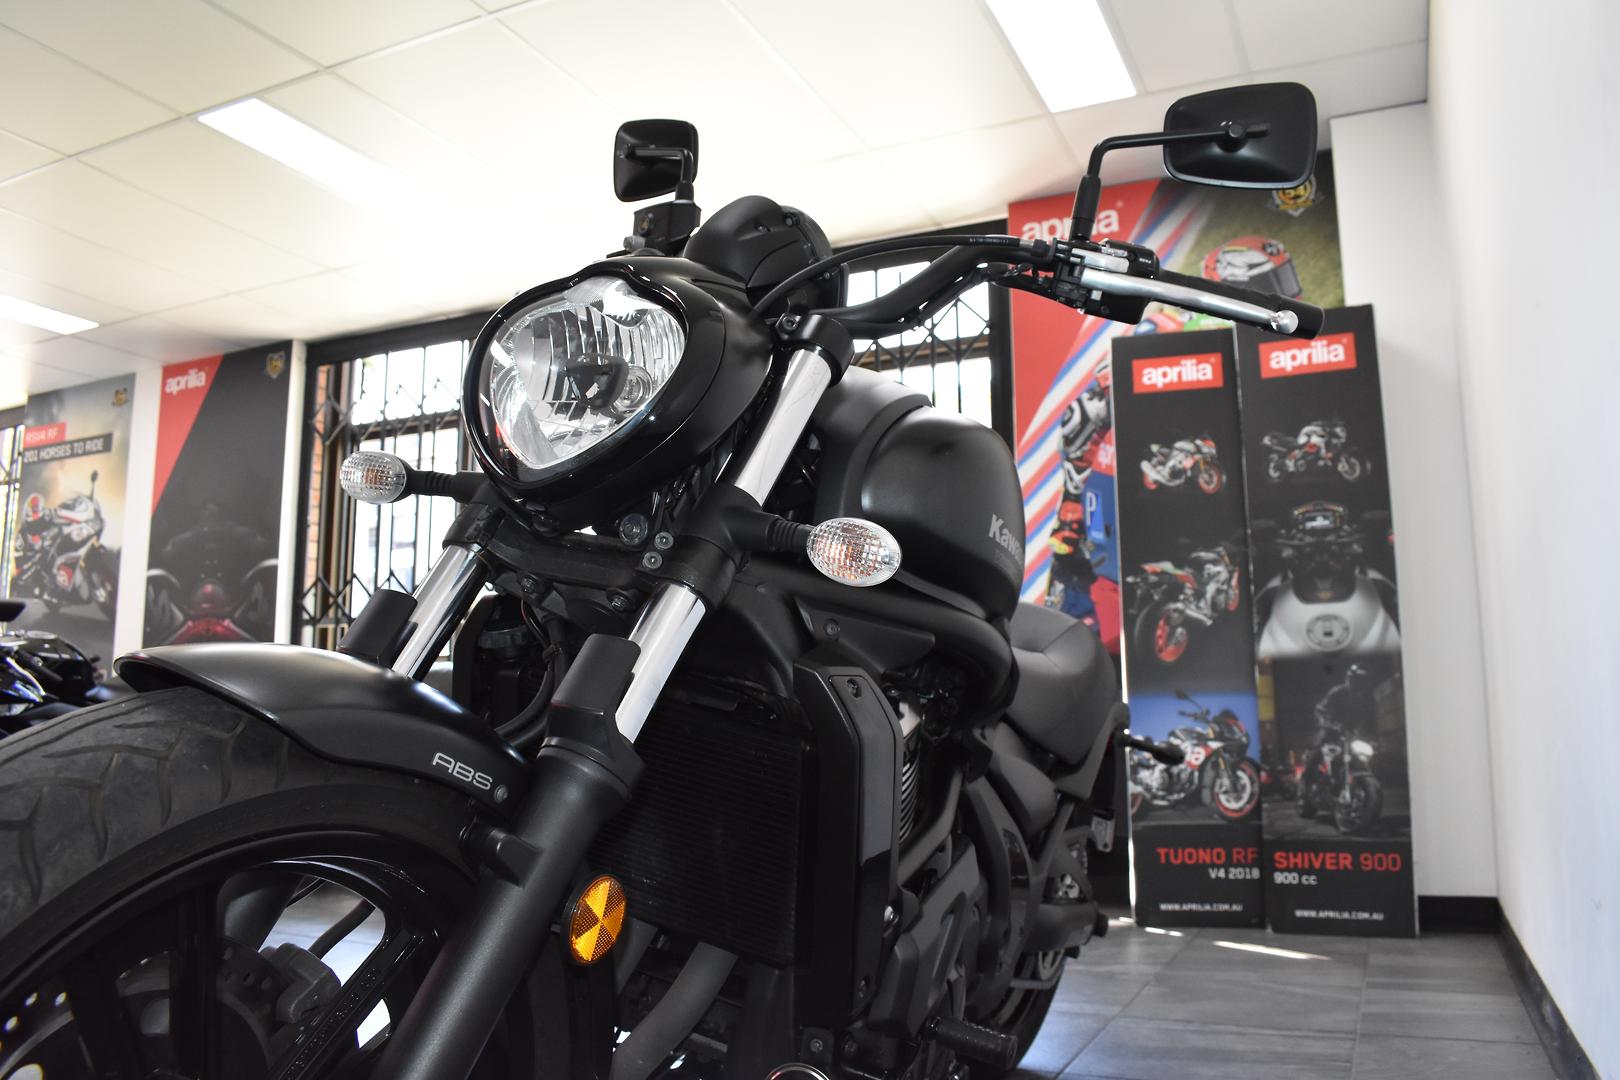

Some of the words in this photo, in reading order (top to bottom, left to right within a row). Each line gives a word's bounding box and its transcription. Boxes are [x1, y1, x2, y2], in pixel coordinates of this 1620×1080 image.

[1022, 210, 1119, 243] apra
[1269, 340, 1344, 371] aprilia
[165, 368, 206, 395] aprilia
[1142, 359, 1212, 388] aprilia
[39, 444, 72, 461] HORSES
[72, 441, 84, 455] TO
[85, 438, 104, 452] RIDE
[432, 752, 493, 790] ABS
[1156, 847, 1226, 865] TUONO
[1232, 847, 1258, 865] RF
[1274, 851, 1352, 870] SHIVER
[1360, 853, 1402, 871] 900
[1208, 867, 1226, 880] V4
[1228, 867, 1260, 880] 2018
[1274, 872, 1300, 884] 900
[1301, 875, 1318, 885] cc
[1159, 903, 1243, 912] WWW.APRILIA.COM.AU
[1295, 909, 1384, 920] WWW.APRILIA.COM.AU
